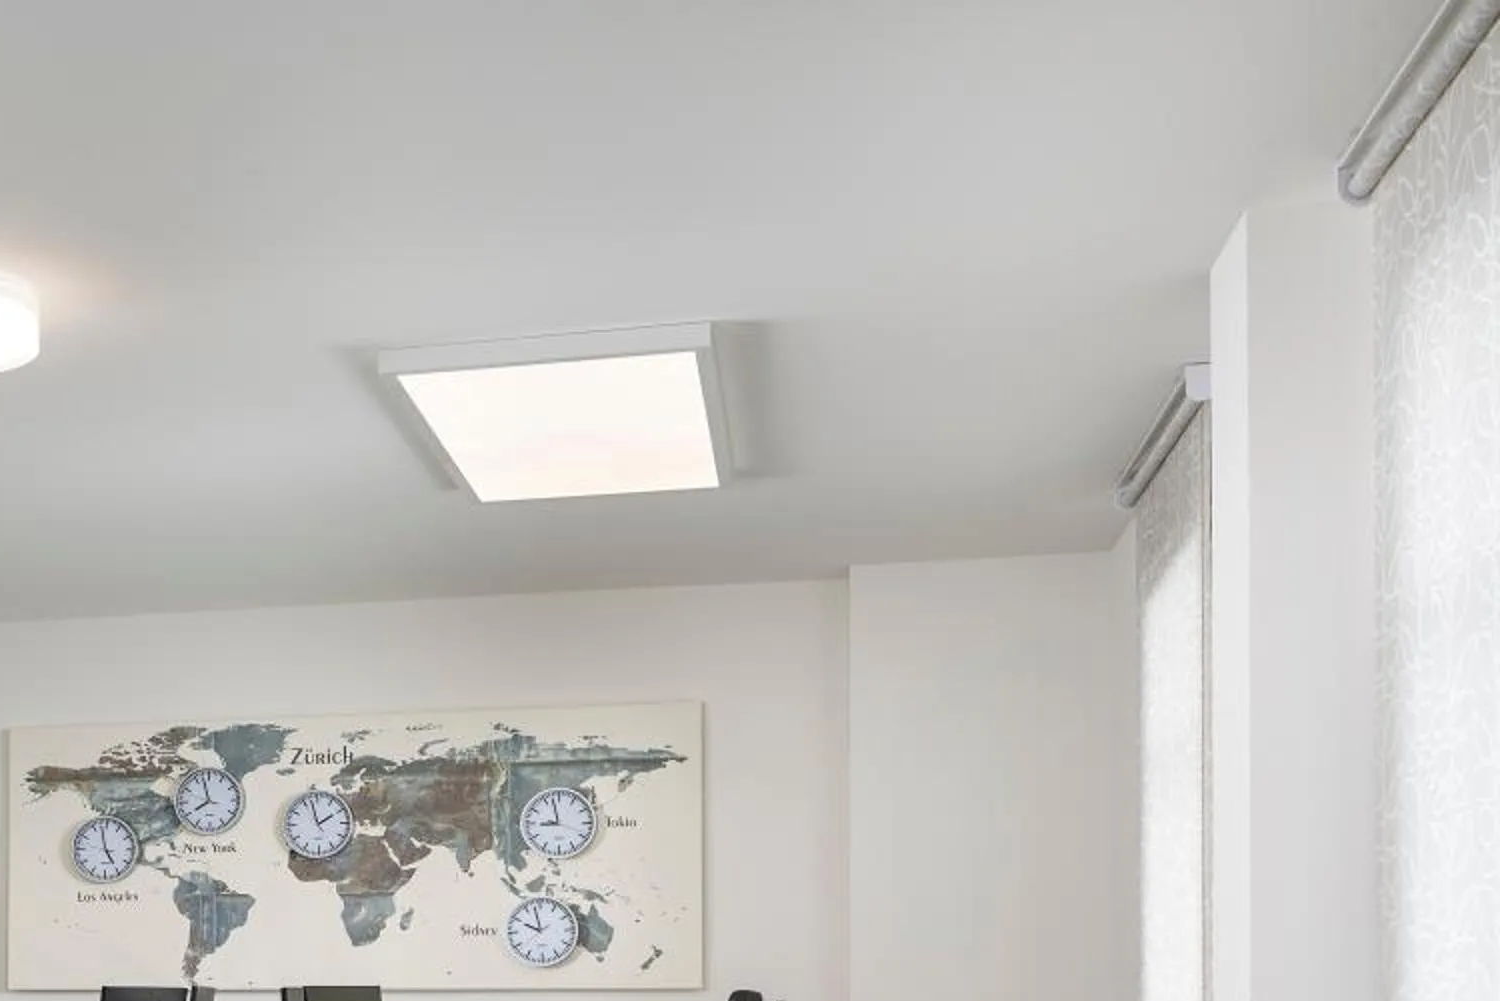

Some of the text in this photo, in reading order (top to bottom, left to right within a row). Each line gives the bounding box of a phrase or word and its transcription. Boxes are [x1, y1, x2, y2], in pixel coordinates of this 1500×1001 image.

[183, 842, 237, 854] New York
[77, 891, 97, 902] Los
